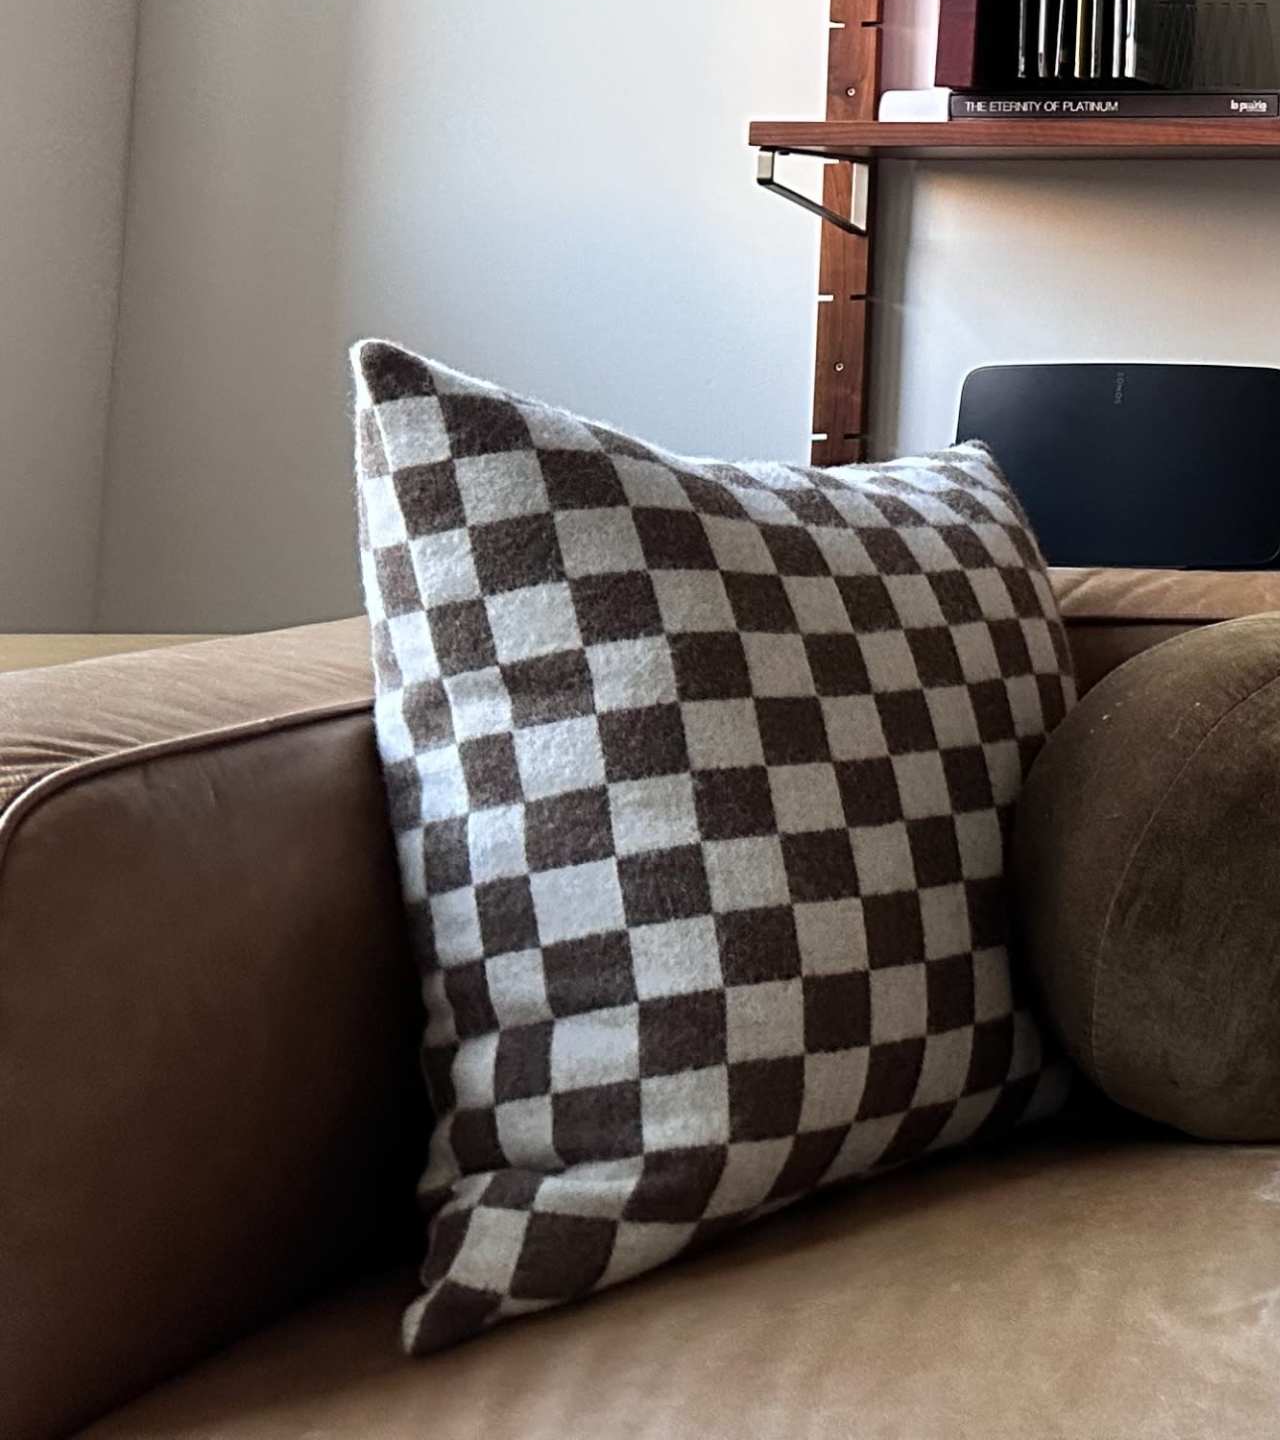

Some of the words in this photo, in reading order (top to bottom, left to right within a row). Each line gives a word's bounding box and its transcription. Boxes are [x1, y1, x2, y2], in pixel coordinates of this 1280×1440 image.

[965, 101, 987, 112] THE
[989, 101, 1043, 112] ETERNITY
[1044, 101, 1062, 112] OF
[1063, 101, 1119, 112] PLATINUM
